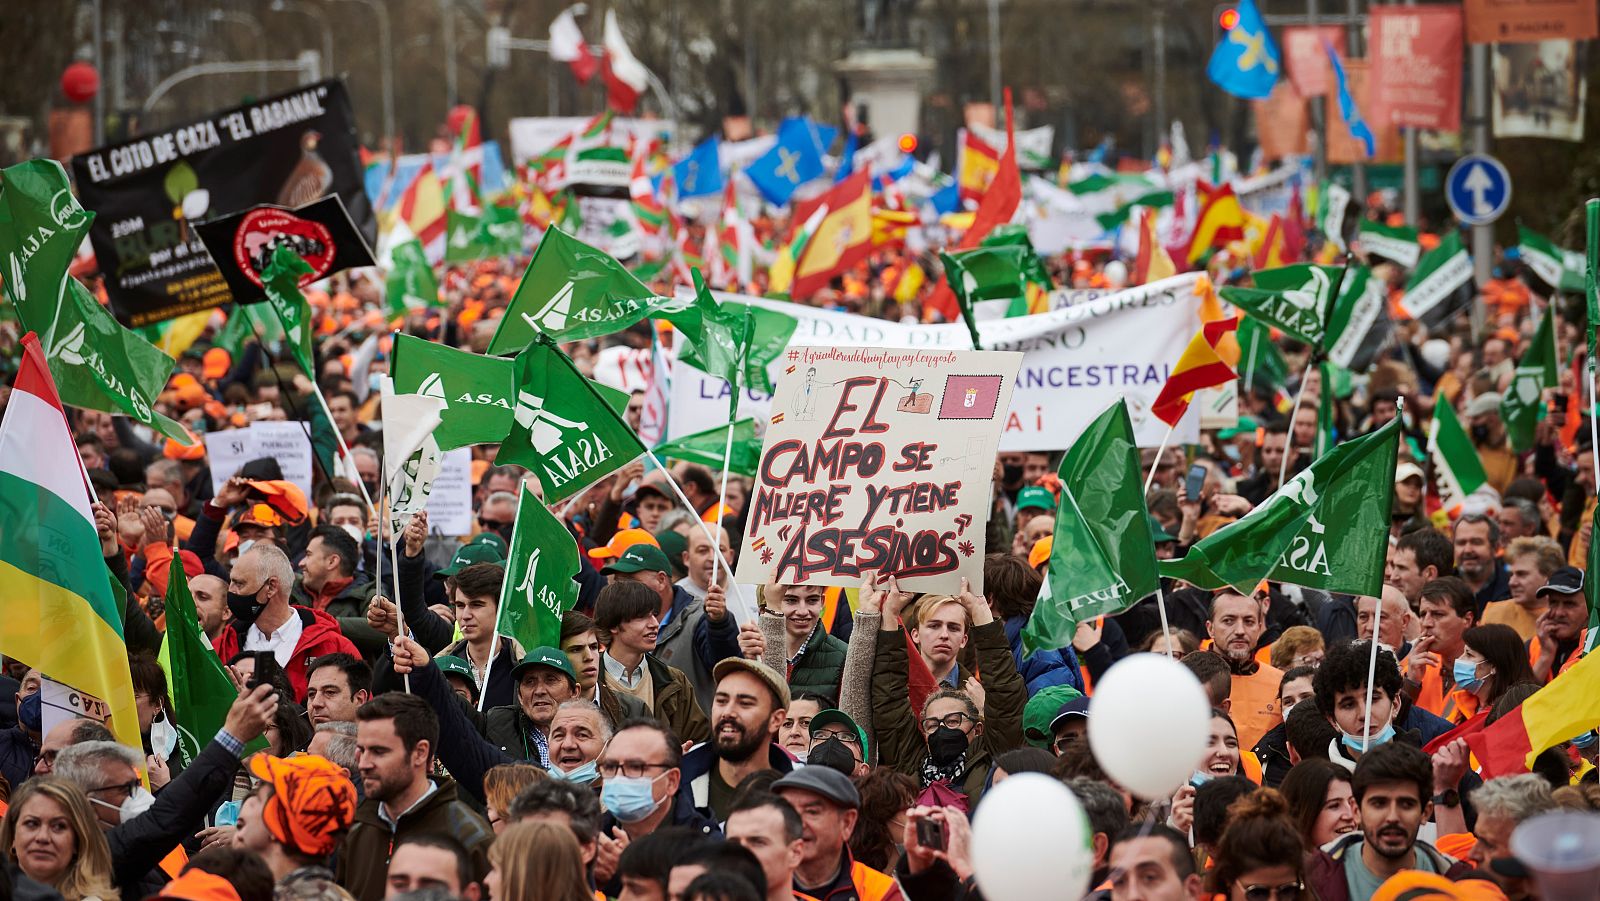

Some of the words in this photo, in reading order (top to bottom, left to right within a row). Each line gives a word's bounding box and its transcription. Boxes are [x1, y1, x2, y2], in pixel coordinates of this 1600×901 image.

[87, 154, 111, 182] EL
[110, 139, 155, 177] COTO
[152, 134, 178, 163] DE
[175, 119, 221, 156] CAZA
[572, 299, 641, 322] ASAJA
[455, 392, 515, 410] ASA
[821, 375, 890, 440] EL
[760, 438, 886, 489] CAMPO
[892, 441, 938, 473] SE
[749, 484, 852, 538] MUERE
